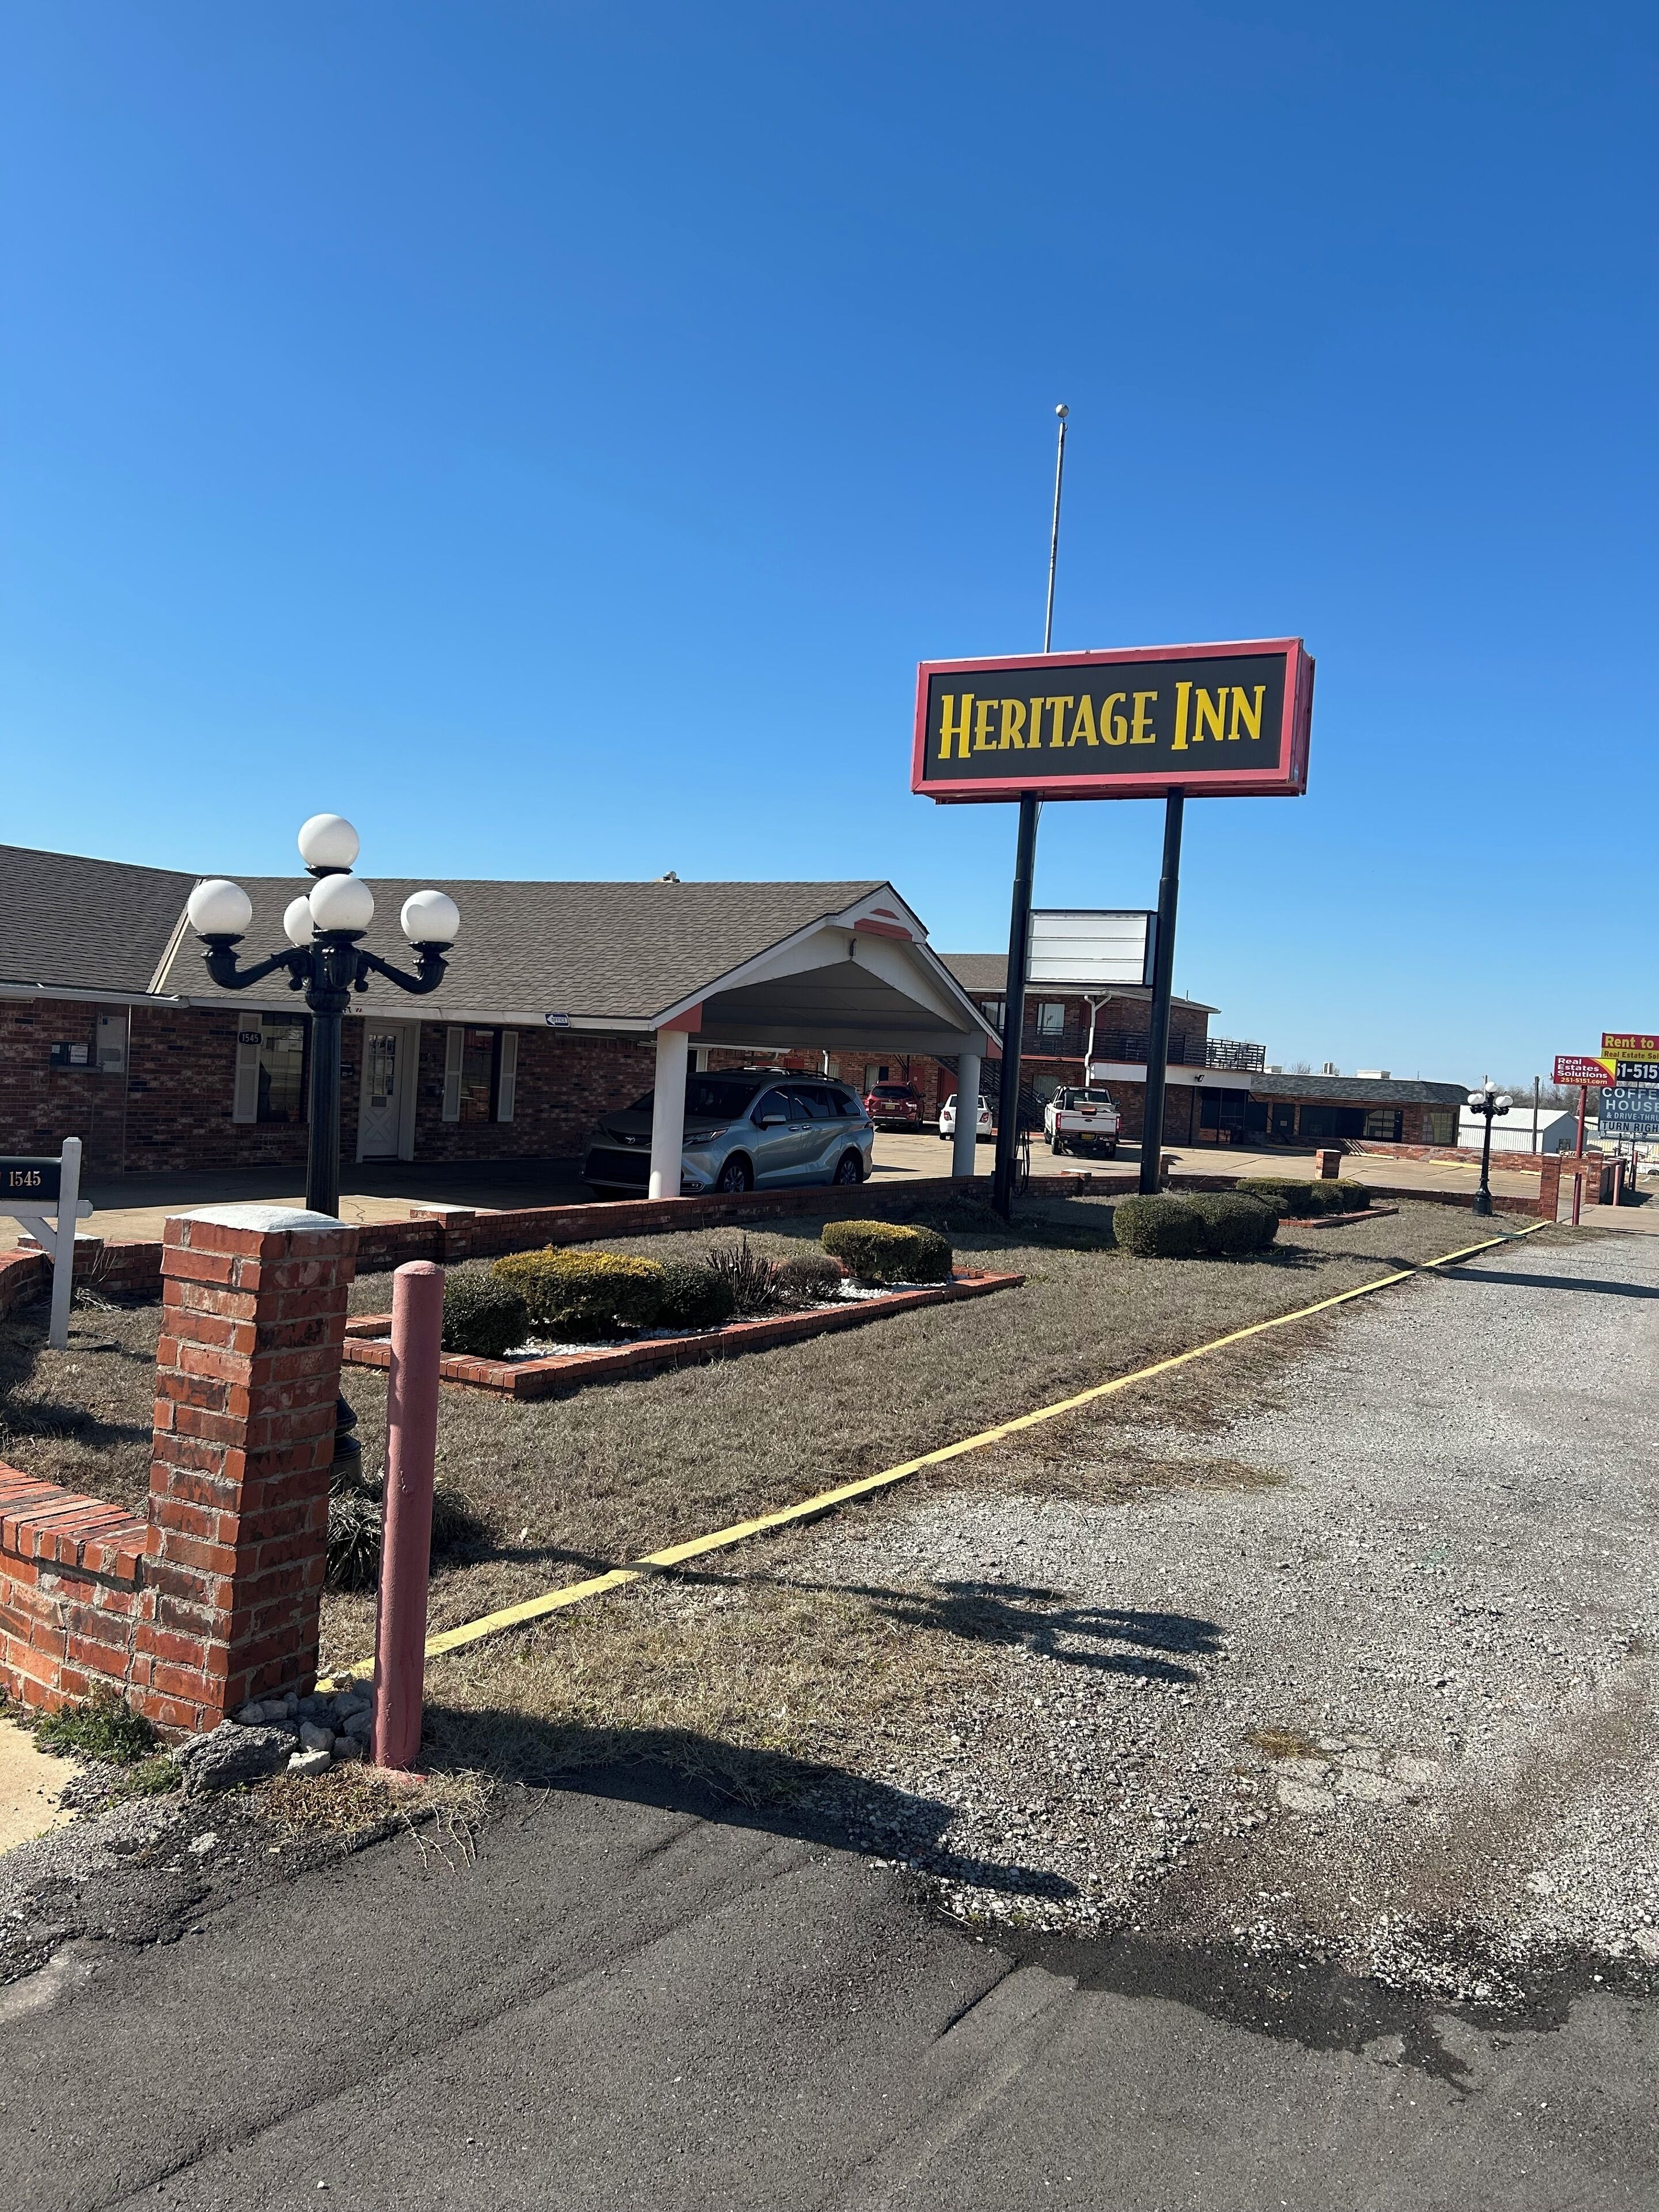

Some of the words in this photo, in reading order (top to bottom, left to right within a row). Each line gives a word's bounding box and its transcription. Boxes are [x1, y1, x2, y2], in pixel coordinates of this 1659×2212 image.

[938, 691, 1158, 759] HERITAGE
[1171, 681, 1266, 751] INN
[242, 1033, 259, 1043] 1545
[1605, 1035, 1636, 1048] Rent
[1641, 1037, 1654, 1049] to
[1558, 1064, 1600, 1072] Estates
[1557, 1070, 1608, 1078] Solutions
[1602, 1121, 1630, 1131] TURN
[1634, 1123, 1658, 1132] RIGH
[9, 1171, 41, 1187] 1545
